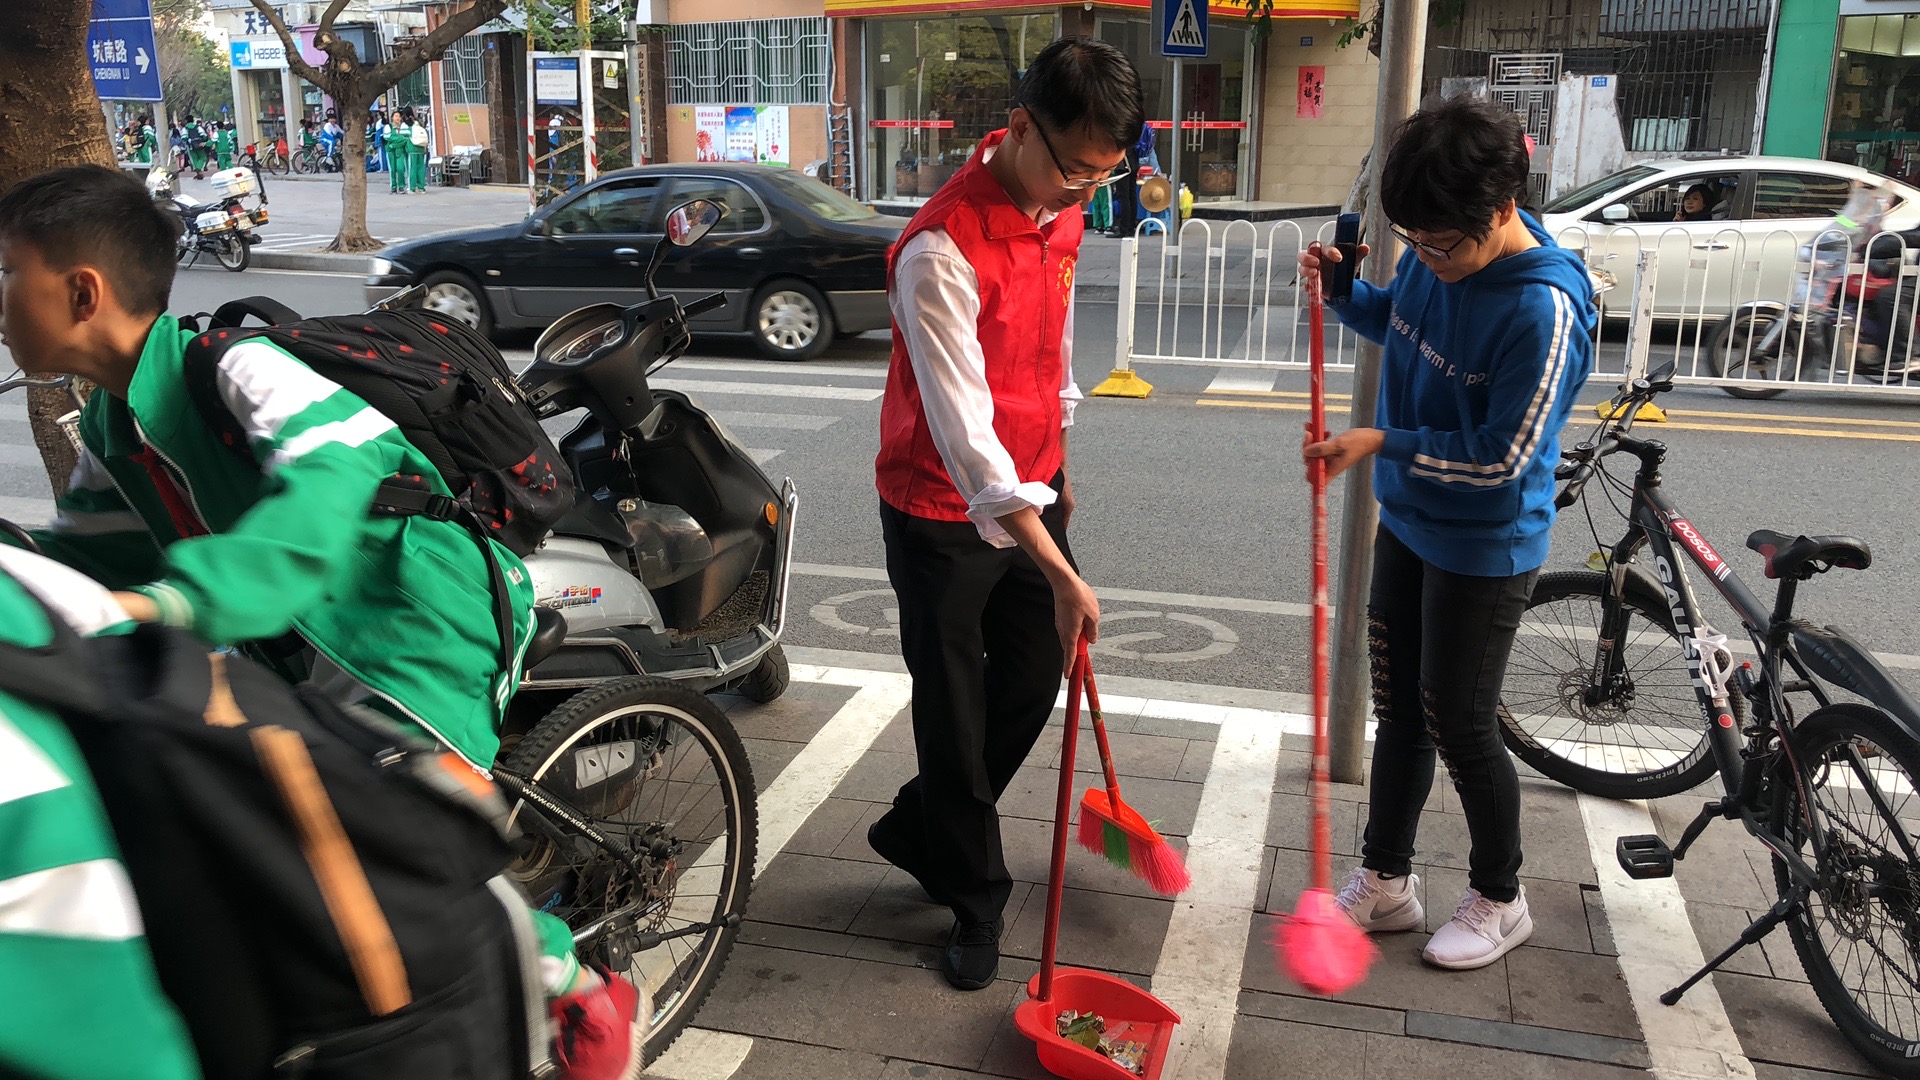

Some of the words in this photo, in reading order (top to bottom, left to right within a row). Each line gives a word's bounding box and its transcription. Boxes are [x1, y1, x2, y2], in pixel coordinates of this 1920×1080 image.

[122, 67, 130, 80] LU
[1418, 340, 1445, 369] warm
[1674, 521, 1718, 563] DOSOS
[522, 786, 604, 843] www.china-xds.com
